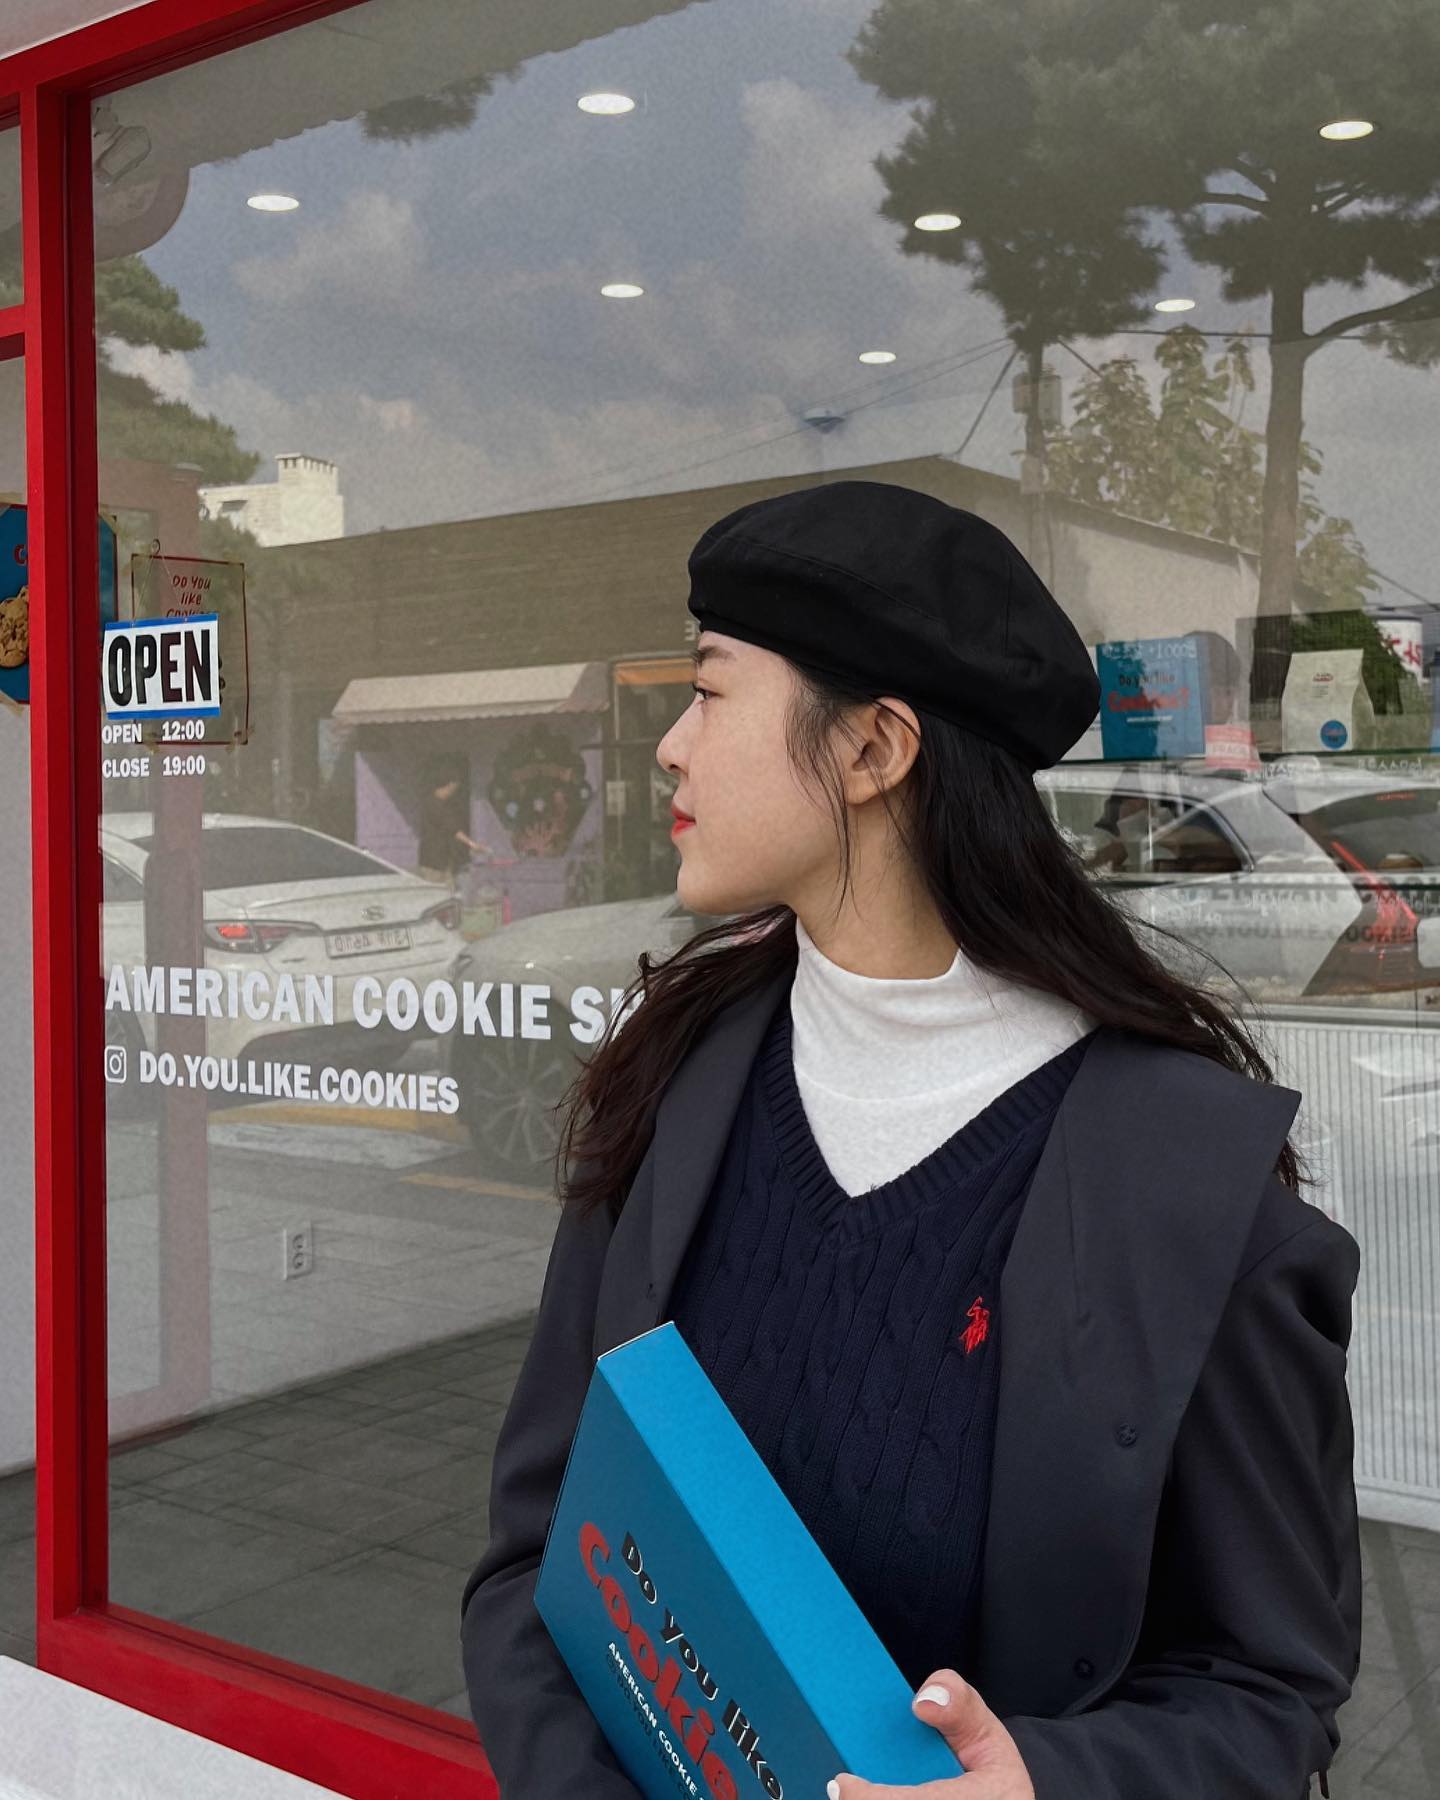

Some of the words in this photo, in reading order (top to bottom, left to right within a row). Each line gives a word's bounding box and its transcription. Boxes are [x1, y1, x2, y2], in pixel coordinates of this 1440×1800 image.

[108, 629, 212, 706] OPEN
[102, 724, 143, 743] OPEN
[162, 720, 205, 741] 12:00
[102, 758, 150, 778] CLOSE
[162, 755, 206, 776] 19:00
[105, 965, 334, 1025] AMERICAN
[352, 976, 552, 1040] COOKIE
[139, 1051, 460, 1114] DO.YOU.LIKE.COOKIES
[621, 1531, 657, 1605] Do
[660, 1608, 718, 1700] you
[722, 1698, 784, 1800] like
[608, 1642, 658, 1728] AMERICAN
[659, 1730, 698, 1796] COOKIE
